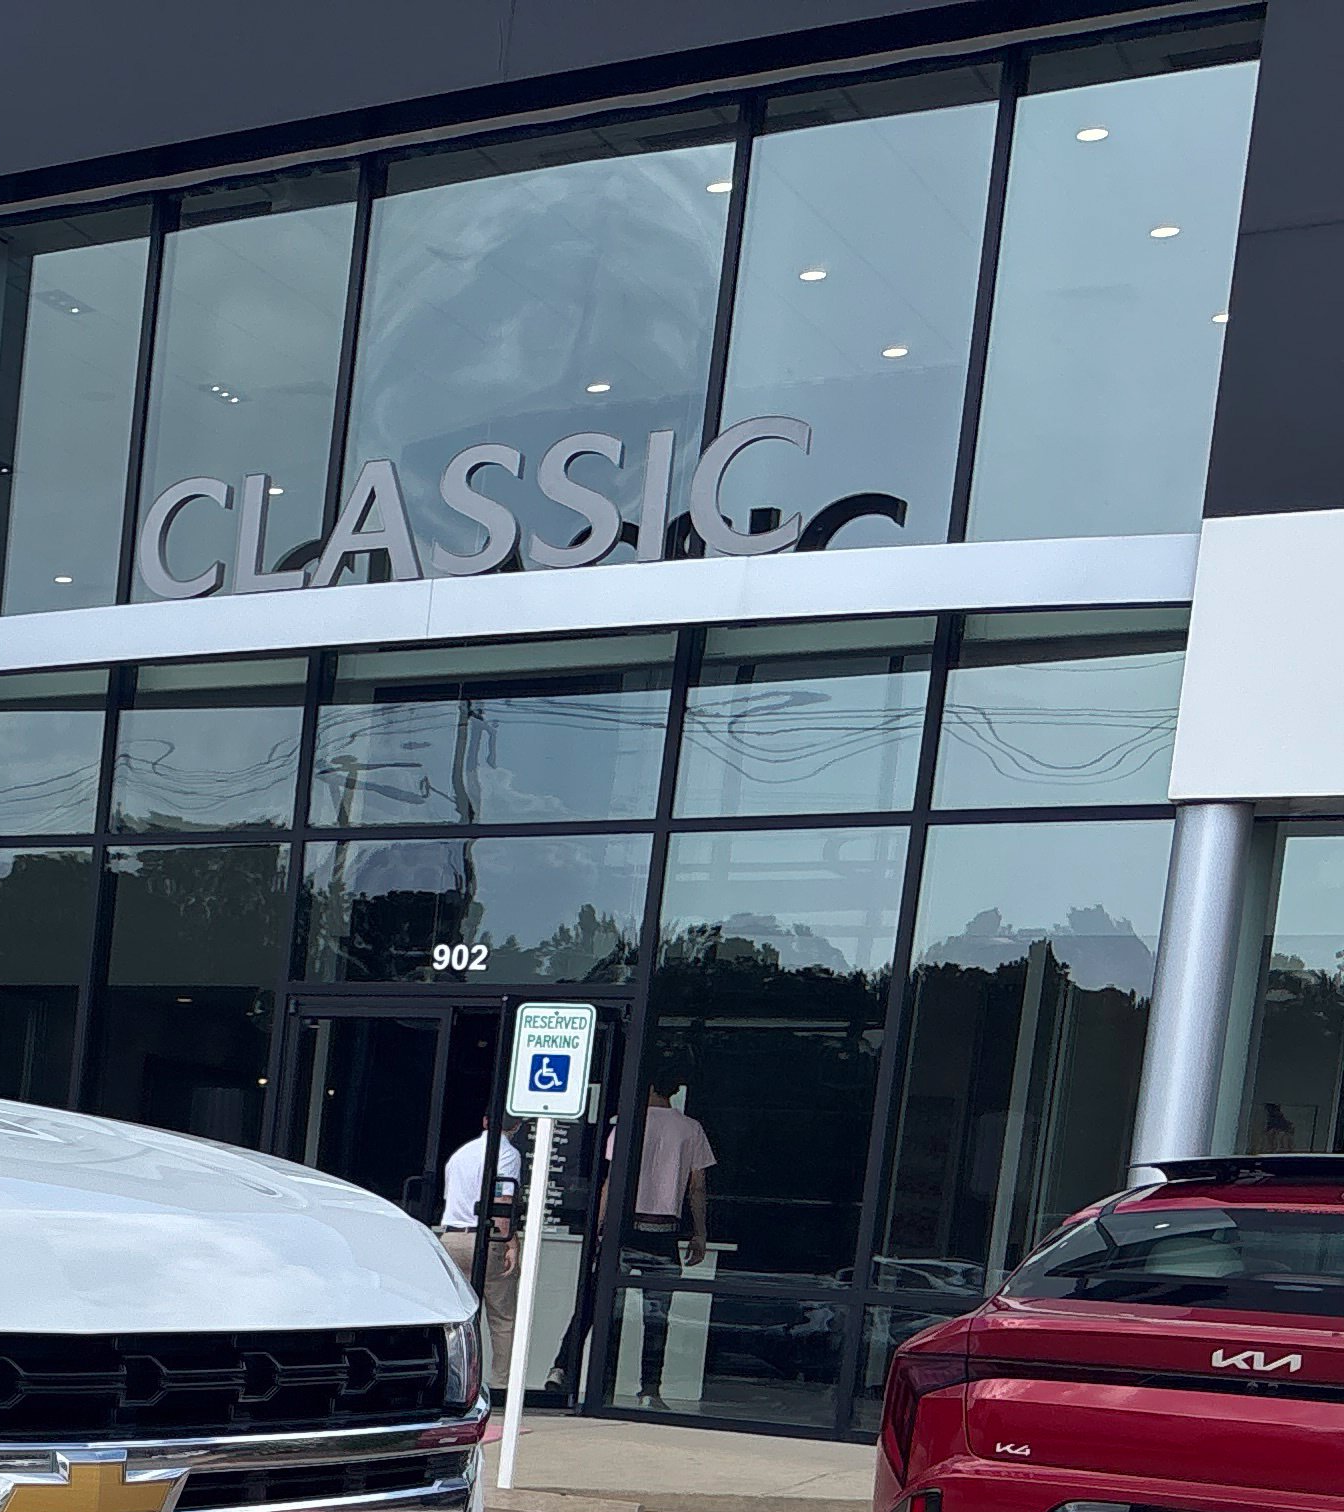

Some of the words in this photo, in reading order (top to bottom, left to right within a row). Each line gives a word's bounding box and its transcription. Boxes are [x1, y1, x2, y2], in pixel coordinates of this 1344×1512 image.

[137, 415, 813, 600] CLASSIC
[433, 944, 488, 971] 902
[523, 1015, 587, 1030] RESERVED
[527, 1034, 580, 1049] PARKING
[1212, 1348, 1302, 1373] KIA
